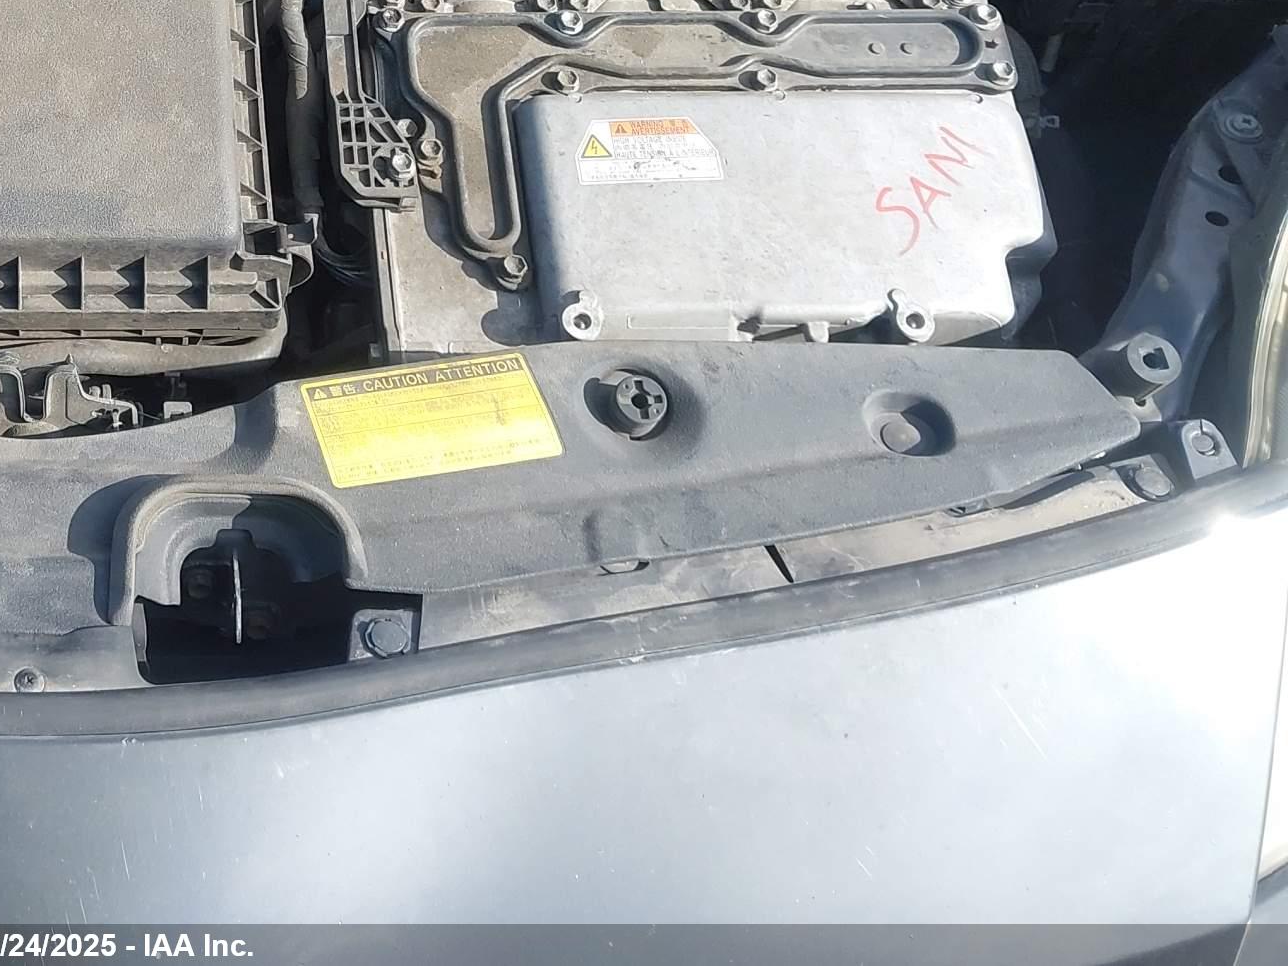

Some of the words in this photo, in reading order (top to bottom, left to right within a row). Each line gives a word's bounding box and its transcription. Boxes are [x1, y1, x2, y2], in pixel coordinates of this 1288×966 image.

[630, 120, 664, 129] WARNING
[631, 127, 690, 135] AVERTISSEMENT
[875, 126, 995, 257] SAM
[362, 372, 429, 392] CAUTION
[434, 359, 520, 382] ATTENTION
